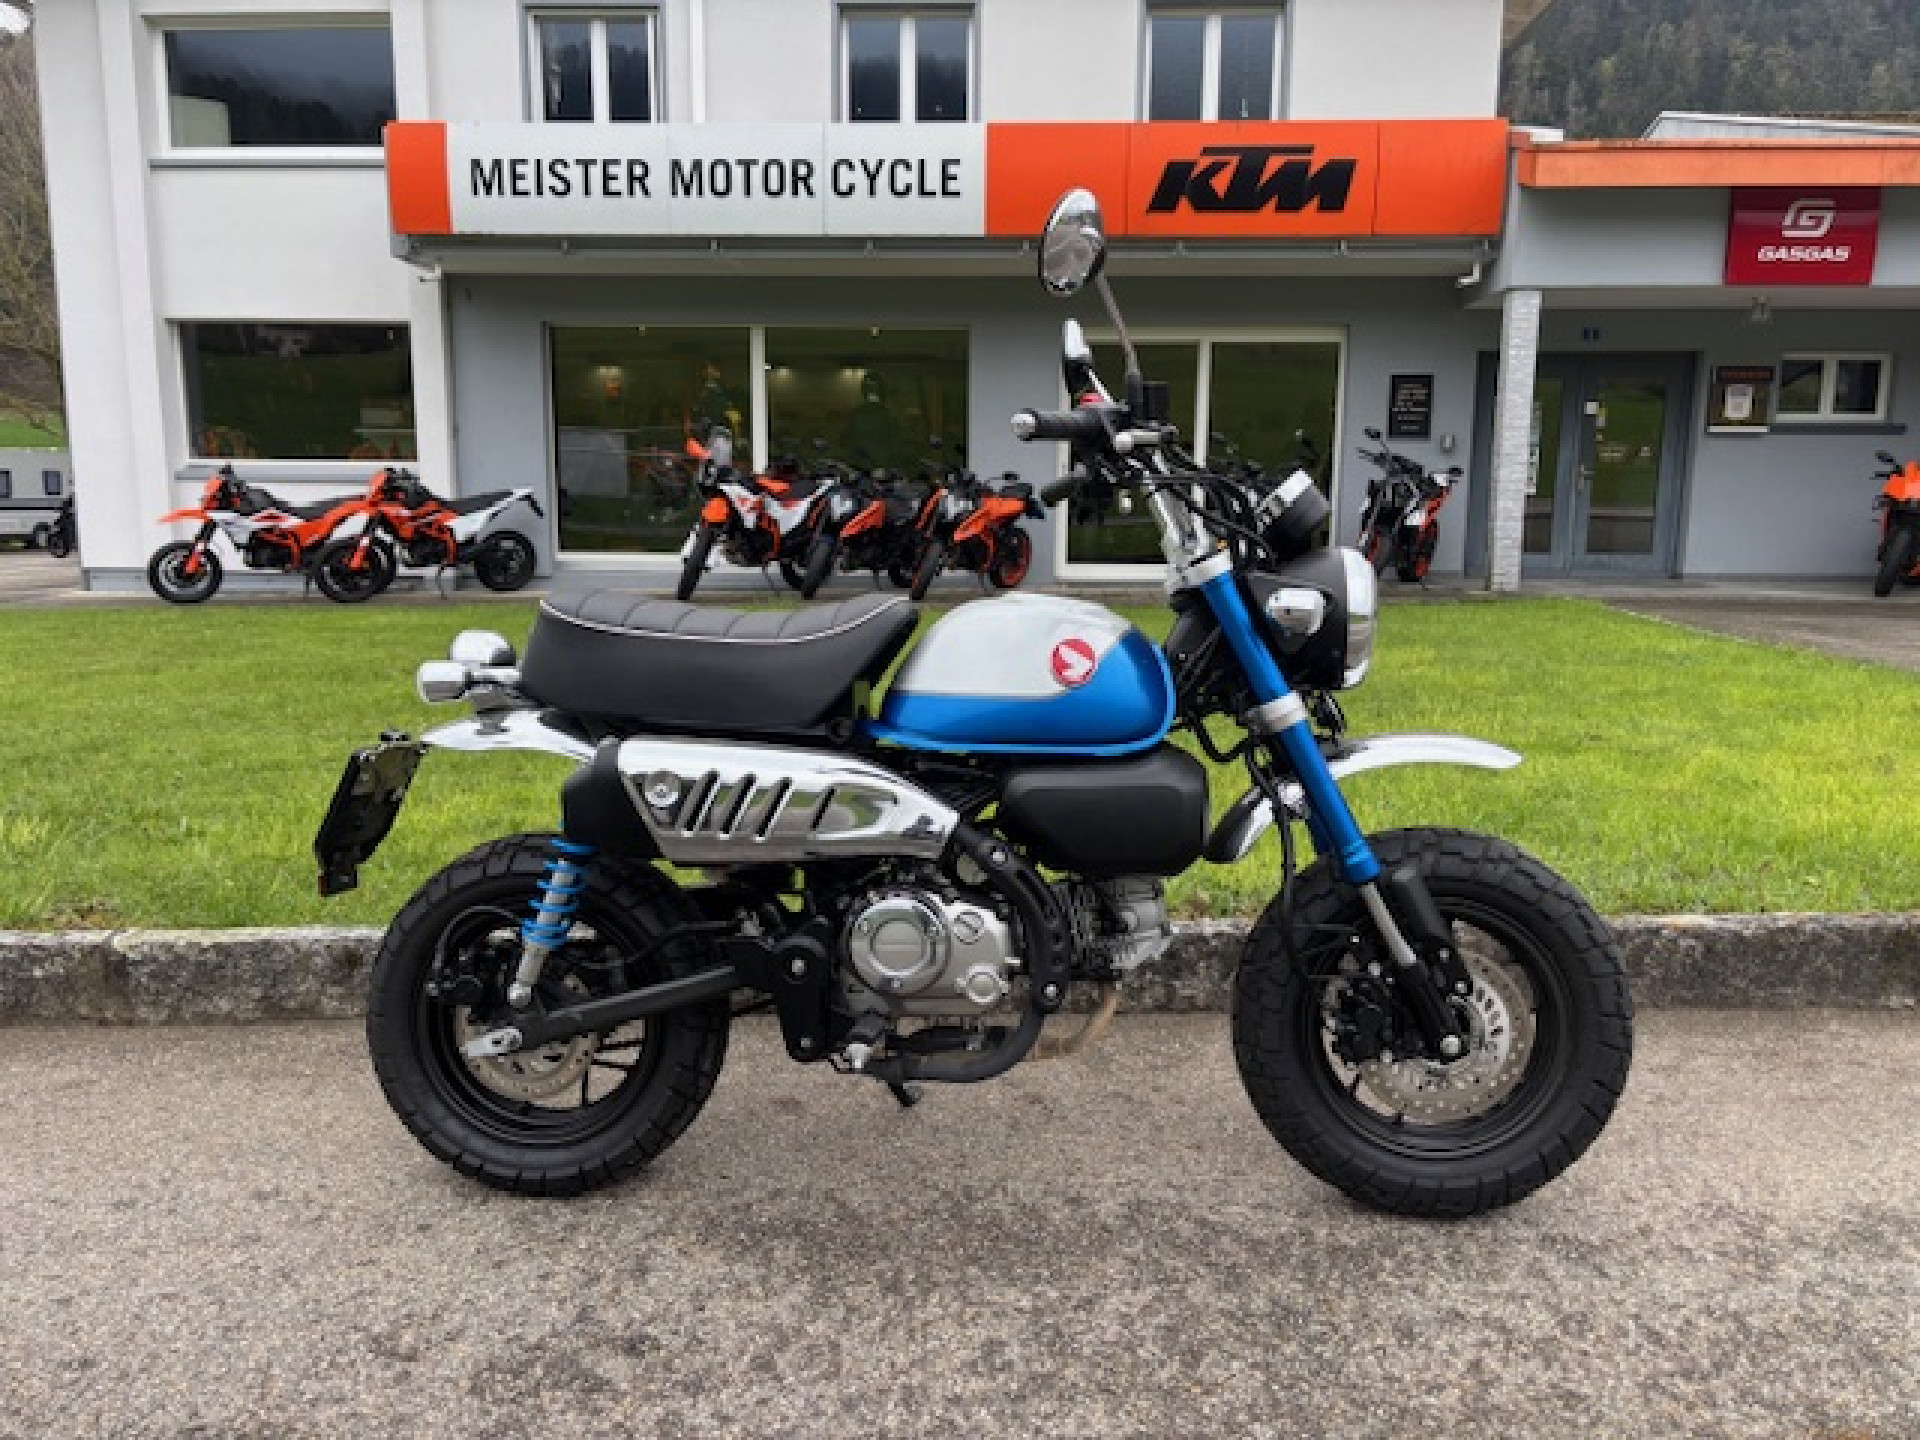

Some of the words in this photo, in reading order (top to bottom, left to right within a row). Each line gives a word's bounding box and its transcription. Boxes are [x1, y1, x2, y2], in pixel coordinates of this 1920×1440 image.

[470, 157, 651, 198] MEISTER
[669, 157, 816, 198] MOTOR
[831, 158, 961, 198] CYCLE
[1146, 144, 1358, 213] KTM
[1757, 245, 1852, 262] GASGAS
